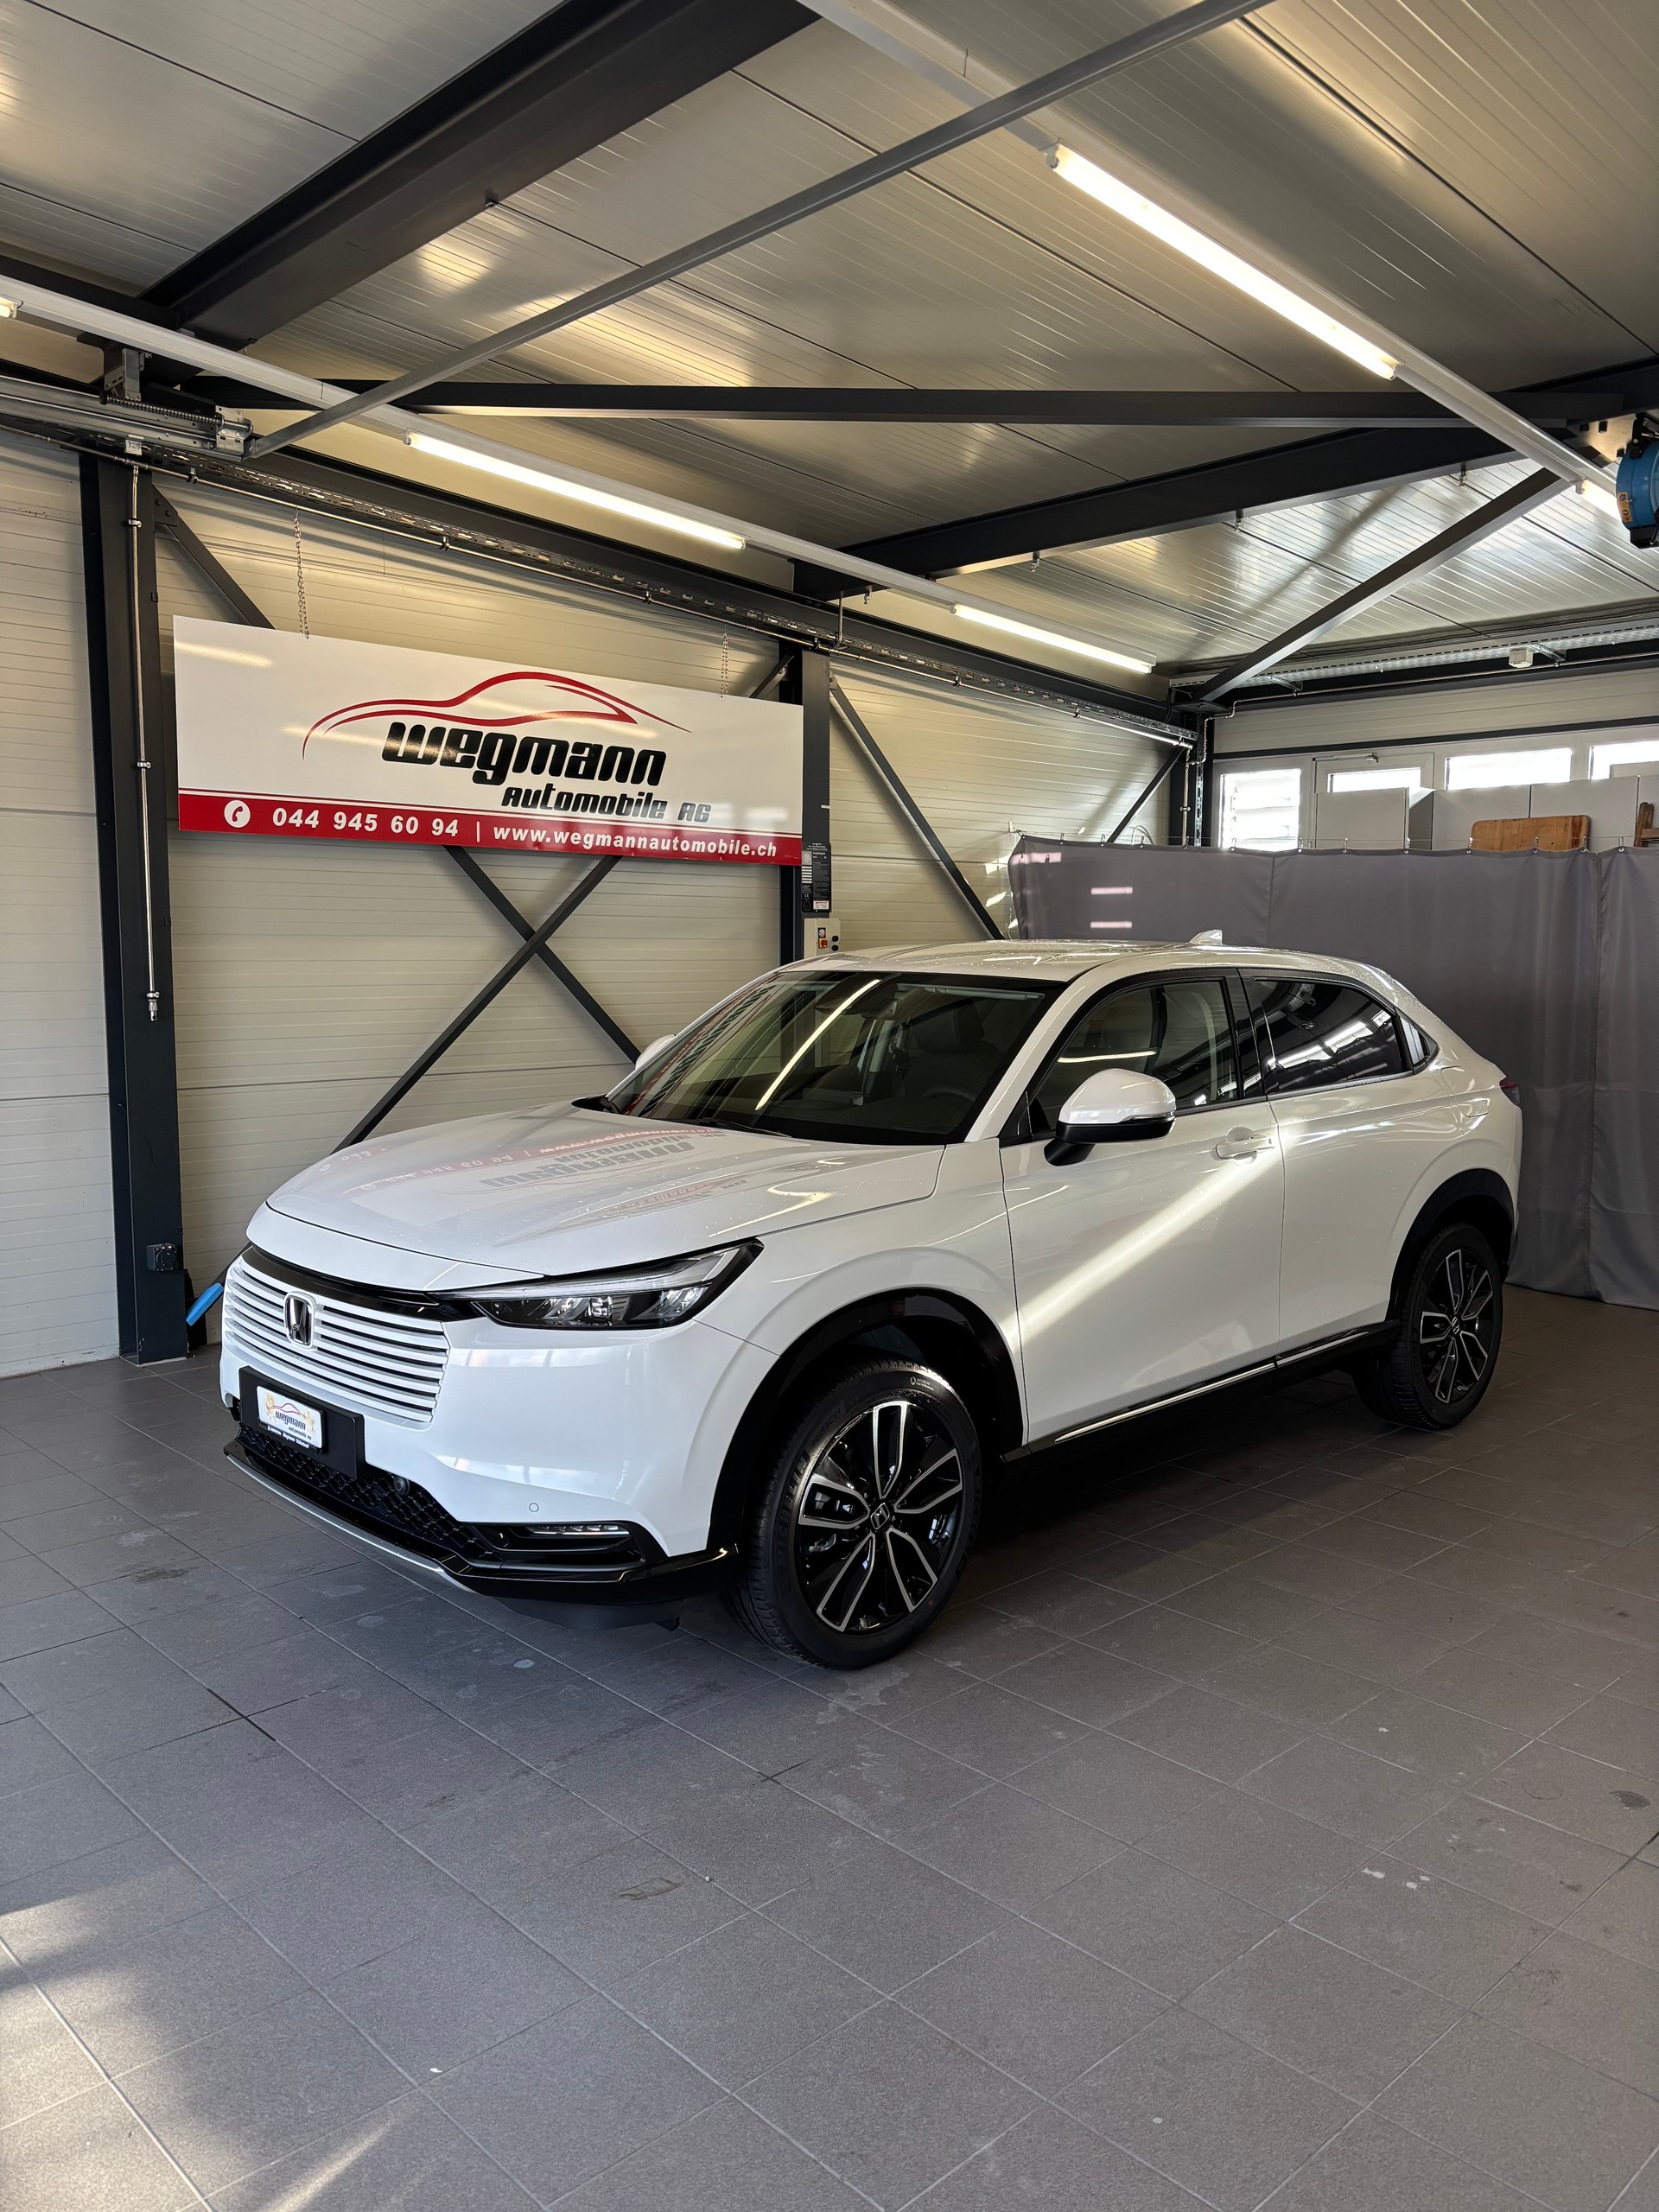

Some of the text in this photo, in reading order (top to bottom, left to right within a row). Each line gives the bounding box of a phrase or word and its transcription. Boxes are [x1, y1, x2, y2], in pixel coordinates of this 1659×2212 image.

[382, 721, 666, 786] wegmann
[501, 783, 712, 823] Automobile AG
[272, 807, 777, 858] 044 945 60 94 www.wegmannautomobile.ch
[275, 1411, 306, 1431] wegmann
